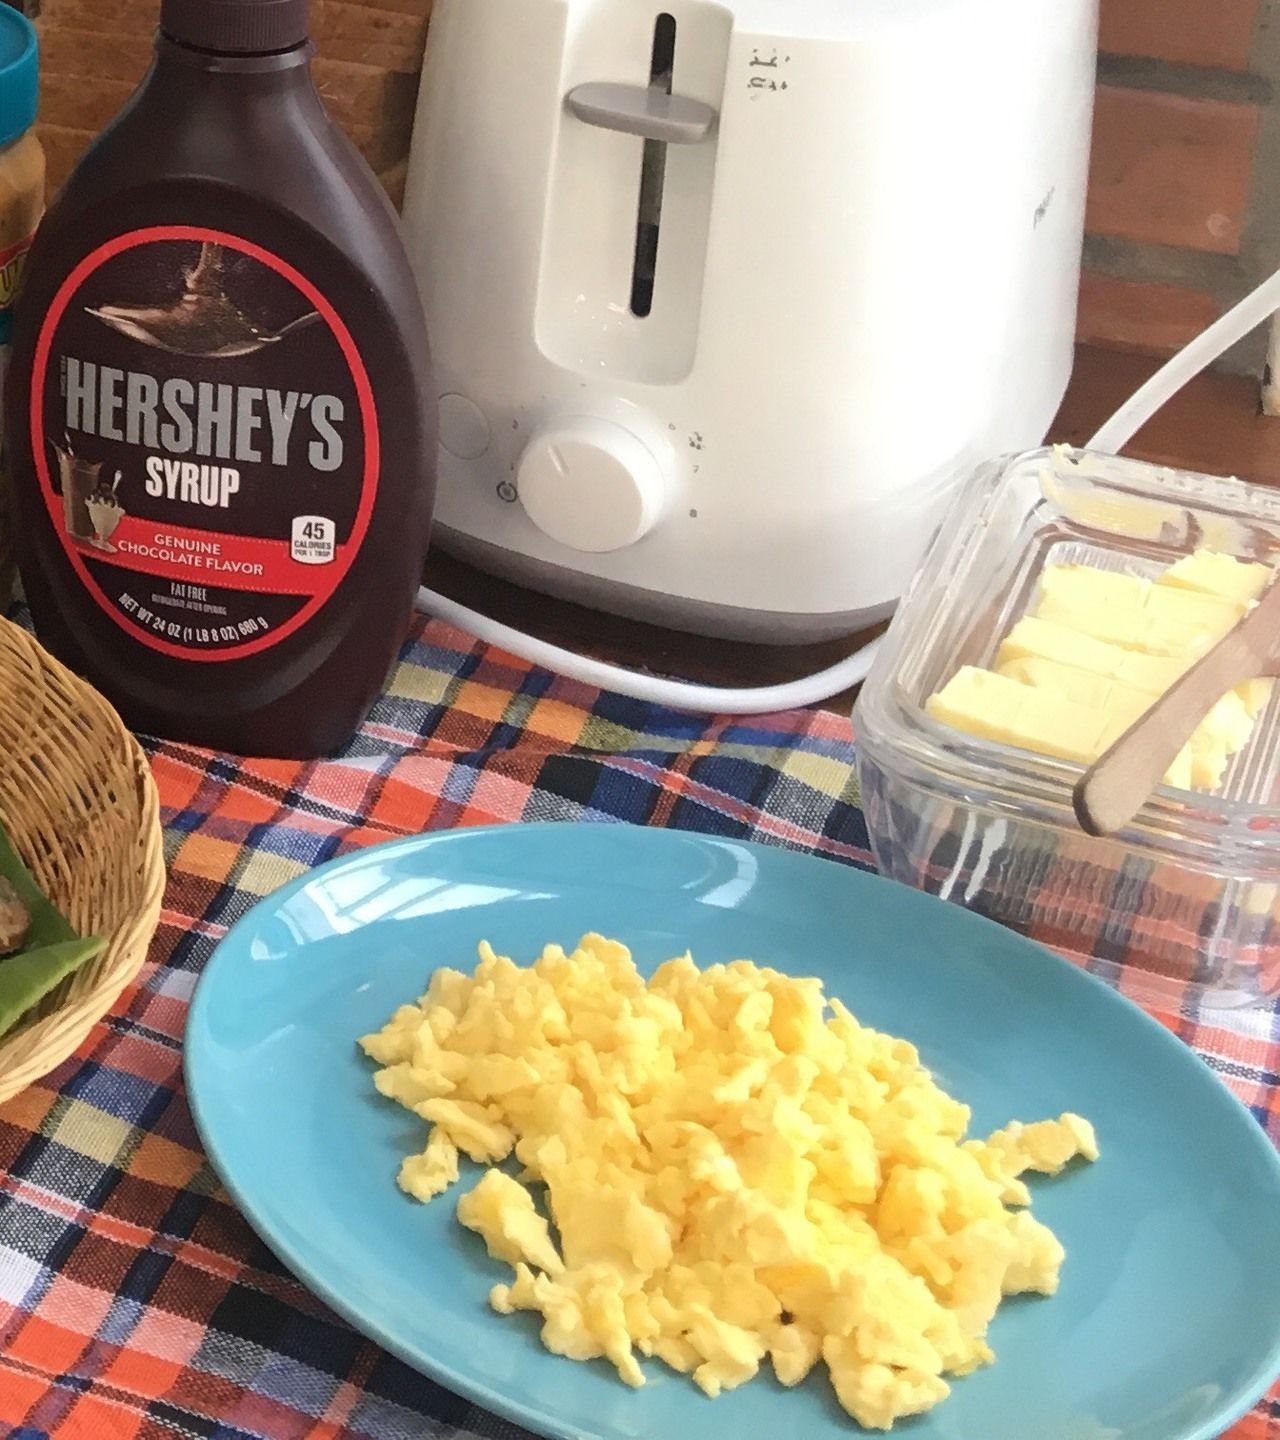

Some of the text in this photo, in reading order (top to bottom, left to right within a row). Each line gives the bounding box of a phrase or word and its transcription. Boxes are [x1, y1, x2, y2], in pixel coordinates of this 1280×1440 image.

[66, 356, 344, 471] HERSHEY'S
[145, 456, 240, 508] SYRUP
[154, 534, 221, 555] GENUINE
[294, 540, 331, 550] CALORIES
[303, 522, 324, 540] 45
[118, 540, 263, 575] CHOCOLATE FLAVOR
[171, 582, 206, 602] FAT FREE
[119, 592, 139, 613] NET
[137, 608, 153, 624] WT
[153, 617, 165, 632] 24
[168, 624, 180, 638] OZ
[196, 630, 209, 642] LB
[221, 626, 239, 641] OZ)
[239, 618, 258, 636] 680
[258, 616, 269, 629] g
